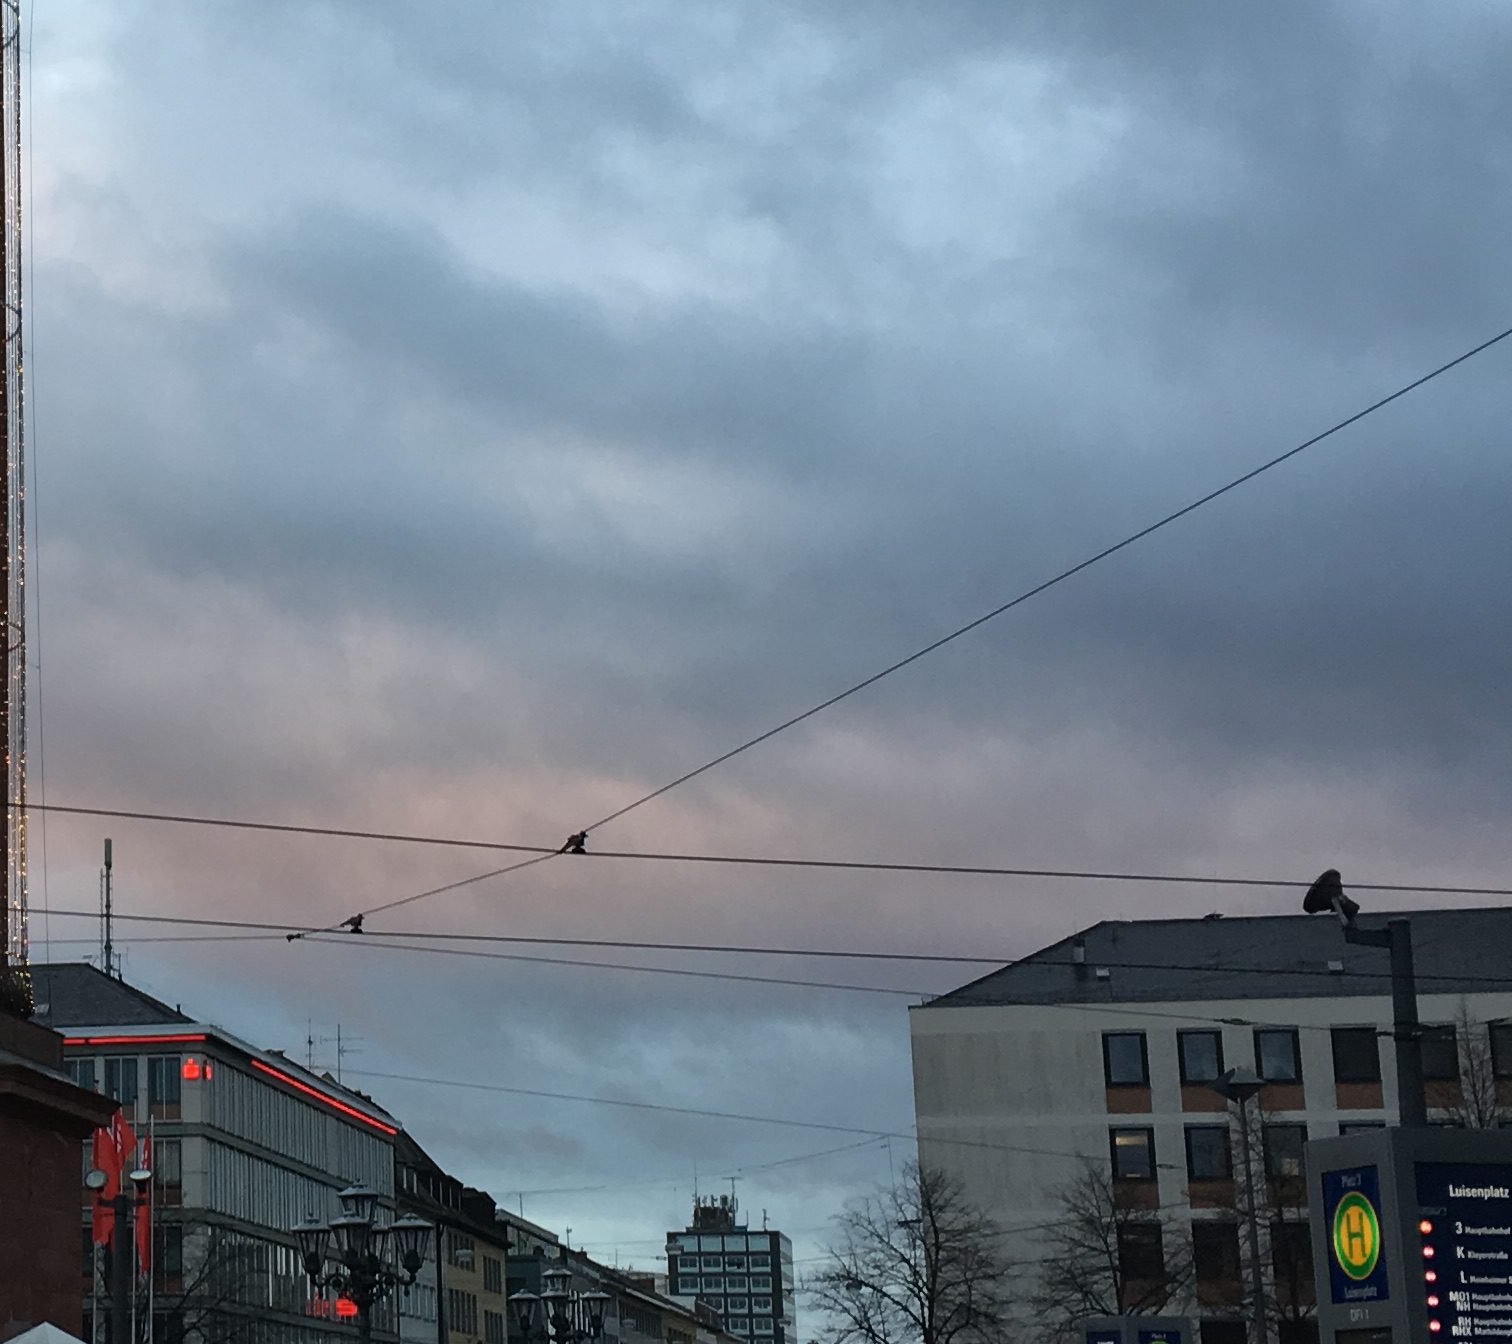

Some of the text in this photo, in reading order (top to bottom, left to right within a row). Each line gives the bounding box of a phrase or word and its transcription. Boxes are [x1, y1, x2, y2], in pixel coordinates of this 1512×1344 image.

[1448, 1184, 1510, 1201] Luisenplatz
[1346, 1212, 1367, 1258] H
[1455, 1221, 1511, 1236] 3 Hauptbahnhof
[1456, 1246, 1465, 1259] K
[1460, 1270, 1468, 1284] L
[1456, 1301, 1471, 1312] NH
